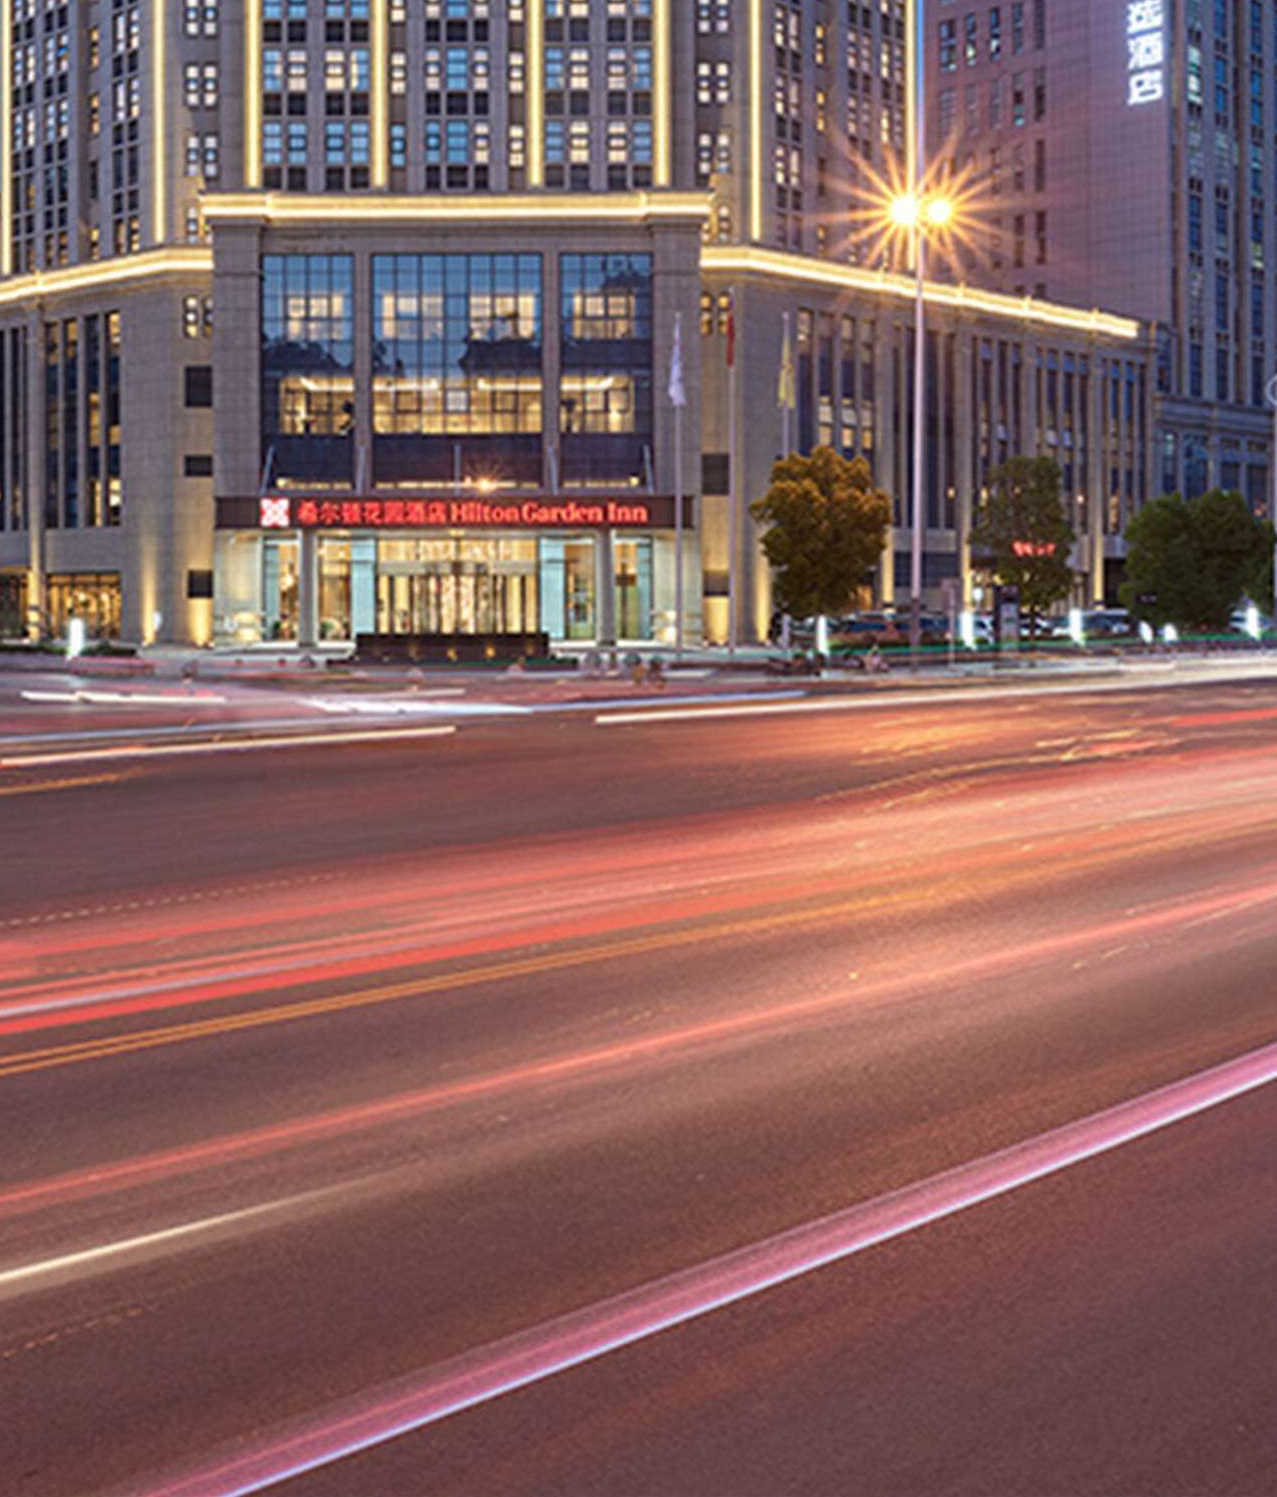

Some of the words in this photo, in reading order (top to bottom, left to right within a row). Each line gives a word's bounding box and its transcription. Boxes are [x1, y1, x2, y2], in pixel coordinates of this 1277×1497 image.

[449, 500, 520, 524] Hilton
[521, 500, 604, 525] Garden
[607, 501, 649, 524] Inn
